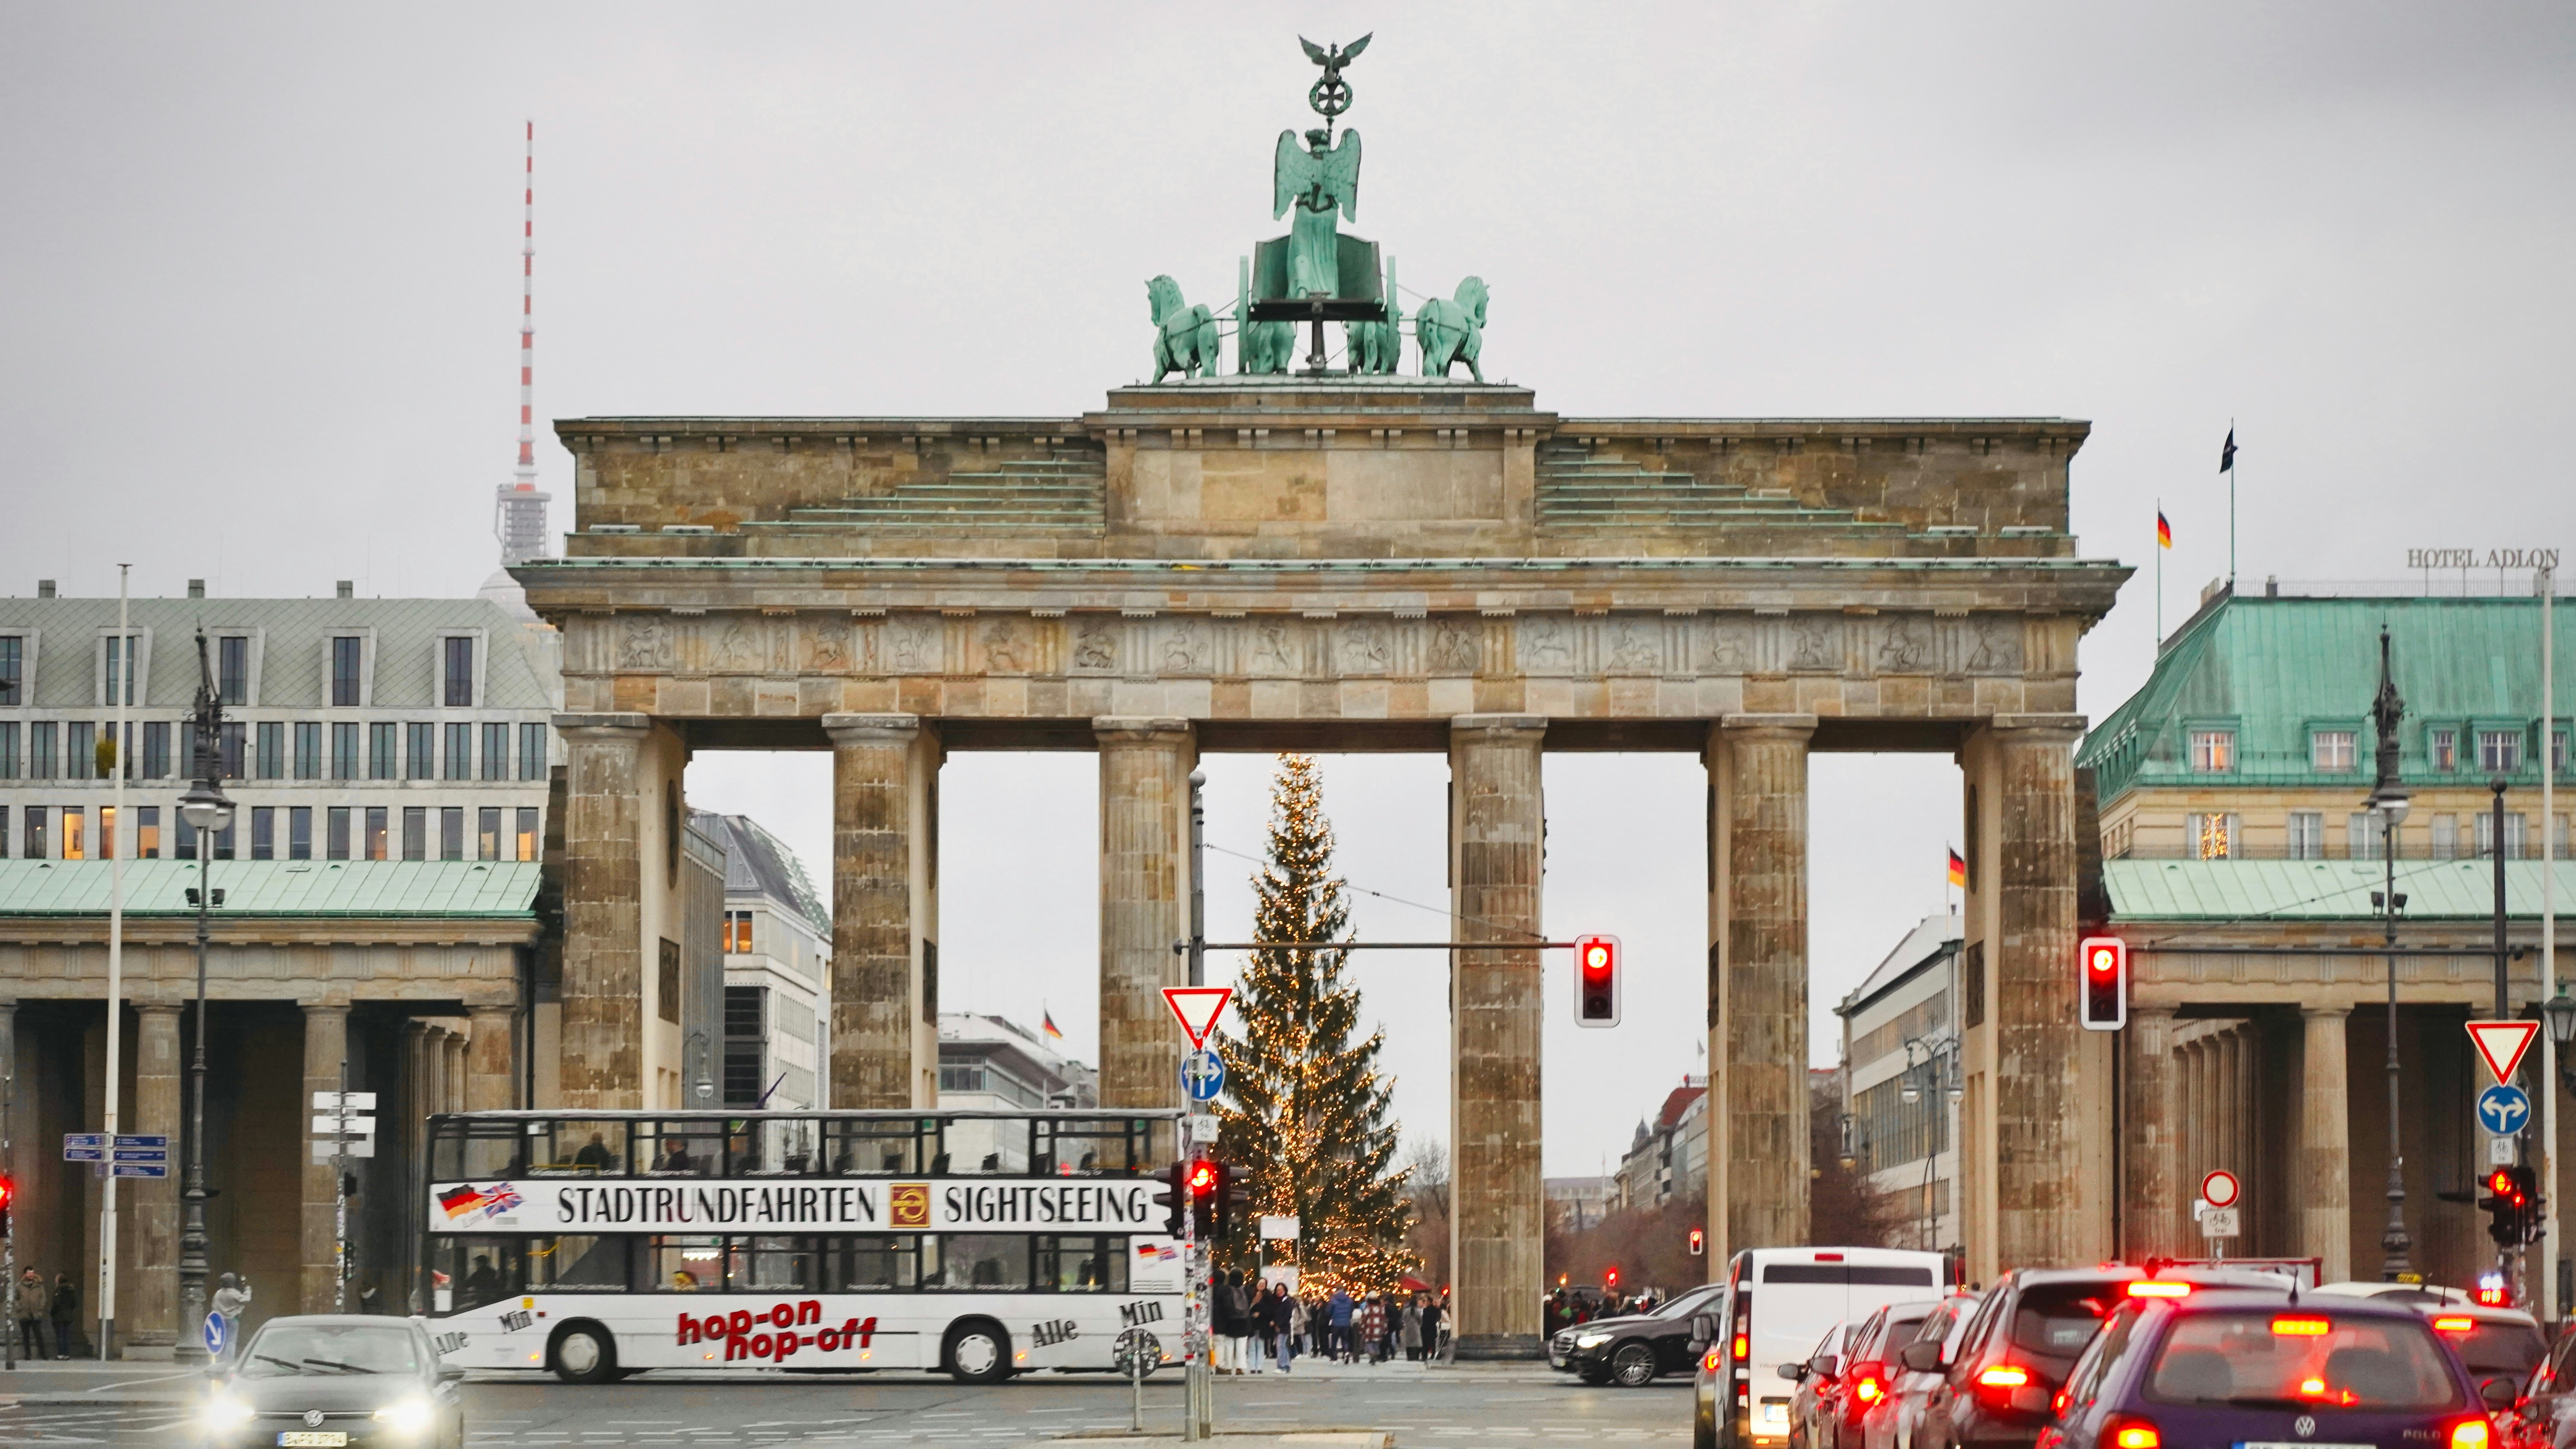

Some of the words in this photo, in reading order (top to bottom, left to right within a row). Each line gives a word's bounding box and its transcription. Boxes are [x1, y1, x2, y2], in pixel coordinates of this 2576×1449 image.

[2407, 549, 2479, 567] HOTEL
[2486, 548, 2560, 567] ADLON
[557, 1187, 876, 1223] STADTRUNDFAHRTEN
[945, 1187, 1147, 1223] SIGHTSEEING
[498, 1311, 533, 1334] Min
[677, 1299, 821, 1346] hop-on
[725, 1316, 877, 1363] hop-off
[1032, 1319, 1079, 1348] Alle
[1118, 1300, 1163, 1328] Min
